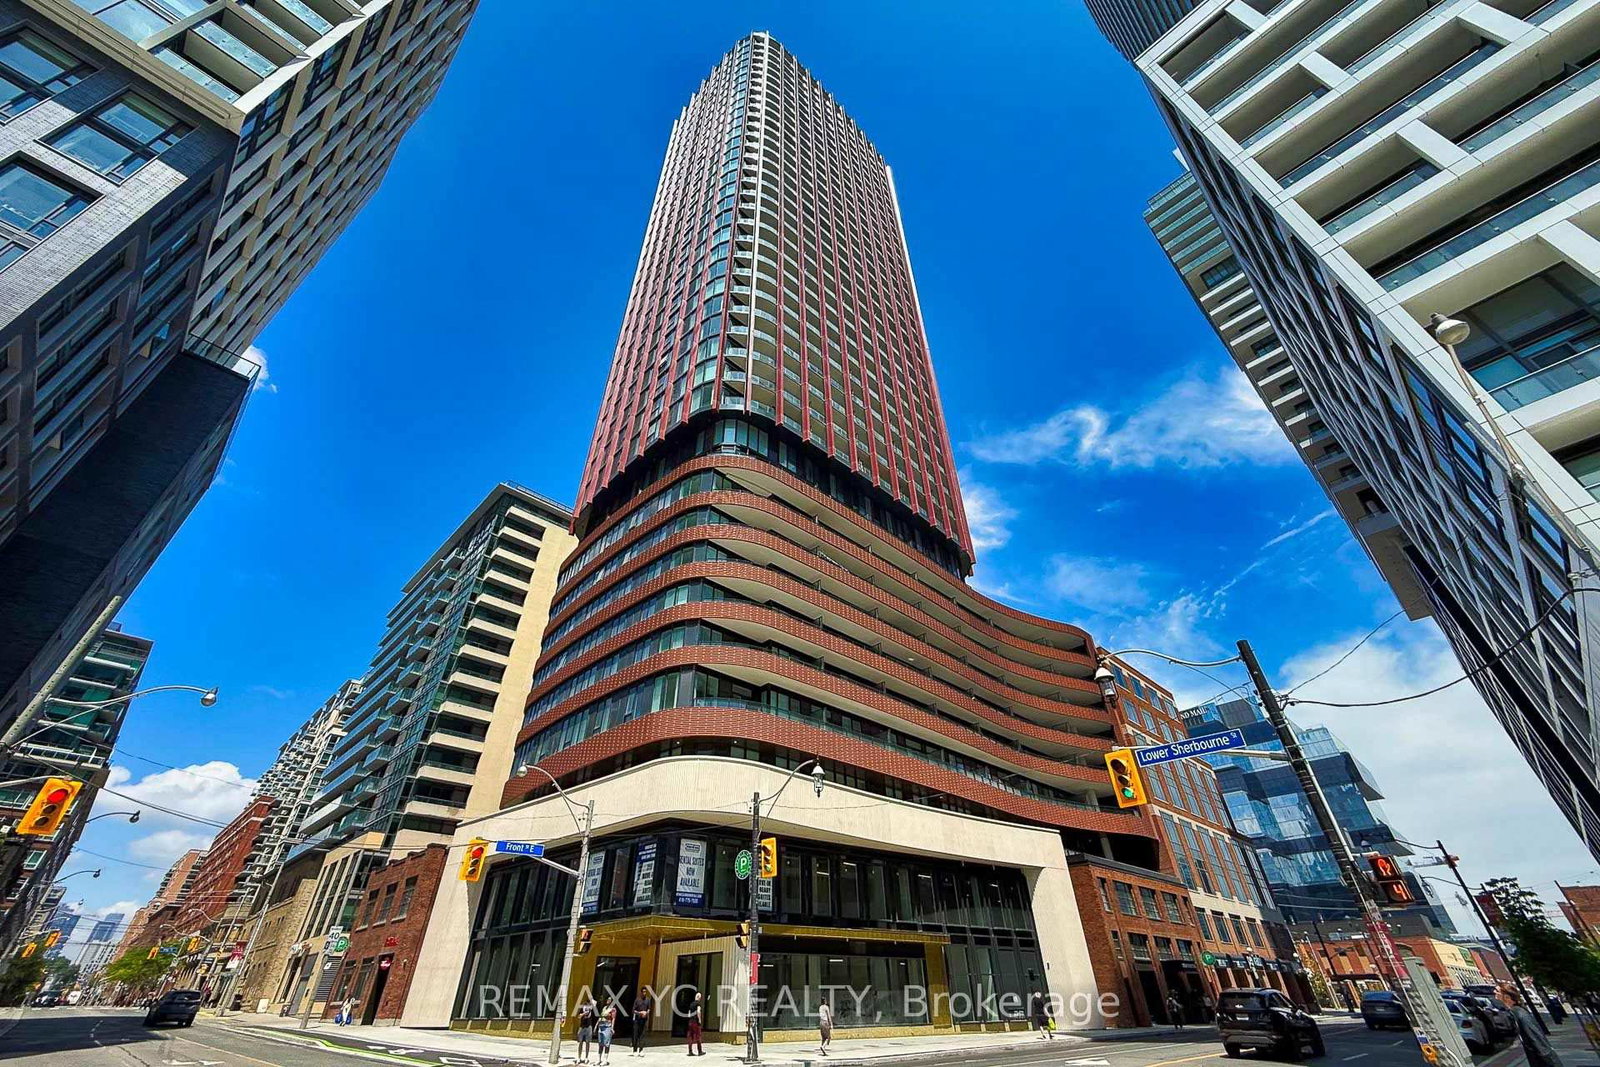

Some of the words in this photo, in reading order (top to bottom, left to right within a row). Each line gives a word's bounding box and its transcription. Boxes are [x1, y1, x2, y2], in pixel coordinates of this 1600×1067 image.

[1140, 748, 1168, 762] Lower
[1170, 735, 1230, 755] Sherbourne
[506, 842, 524, 852] Front
[530, 844, 535, 853] E
[1392, 883, 1408, 900] 4
[328, 932, 340, 940] 40
